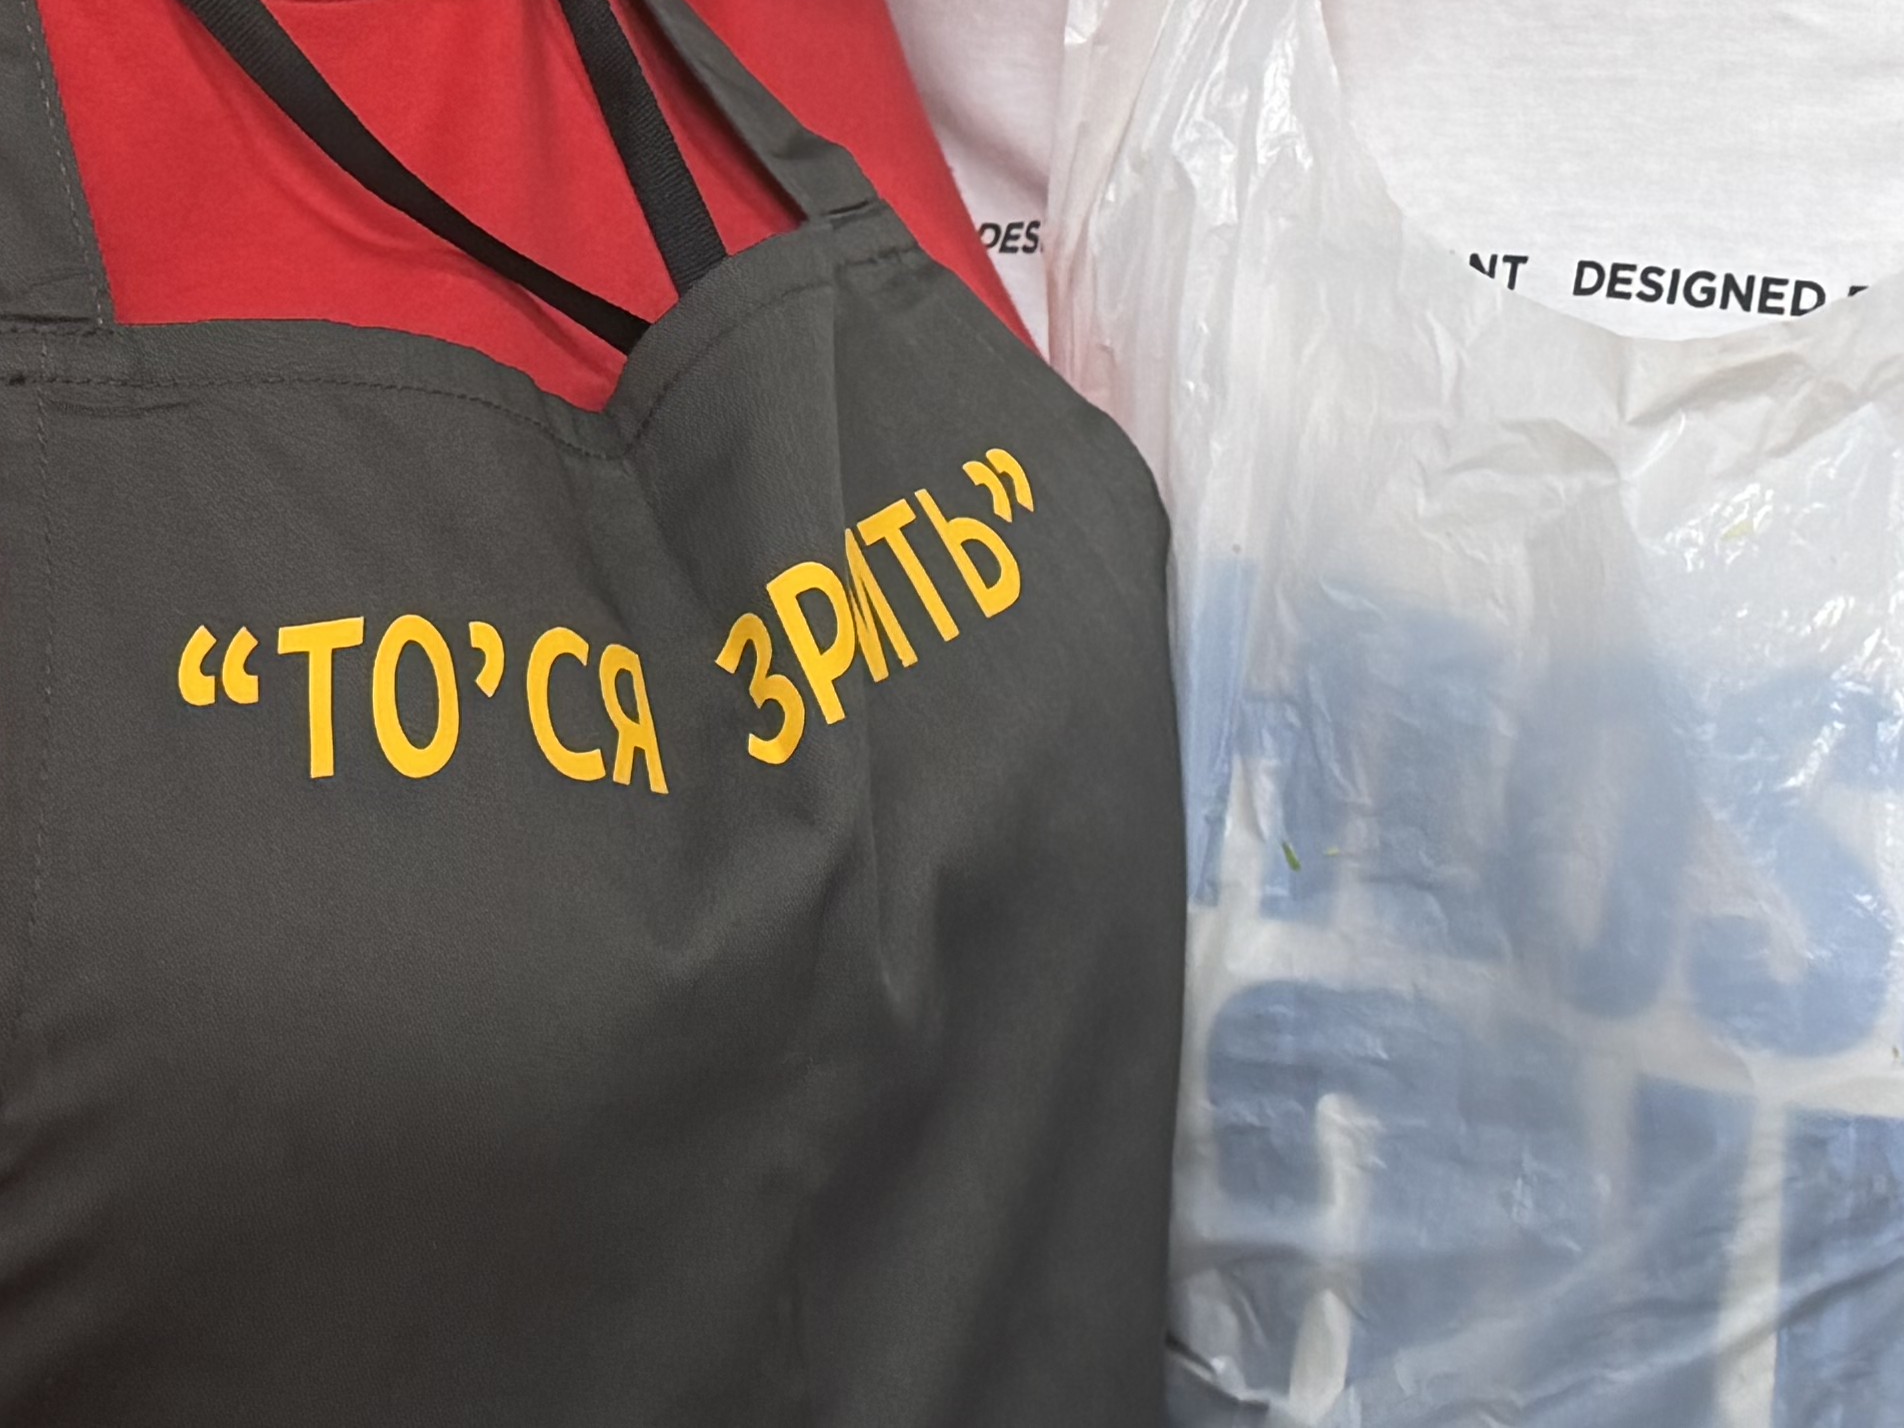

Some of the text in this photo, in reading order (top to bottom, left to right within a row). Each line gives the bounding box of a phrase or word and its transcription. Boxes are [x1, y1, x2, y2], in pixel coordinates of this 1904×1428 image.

[977, 220, 1043, 254] DES
[1572, 259, 1826, 317] DESIGNED
[177, 448, 1036, 794] “ТО’СЯ ЗРИТЬ”
